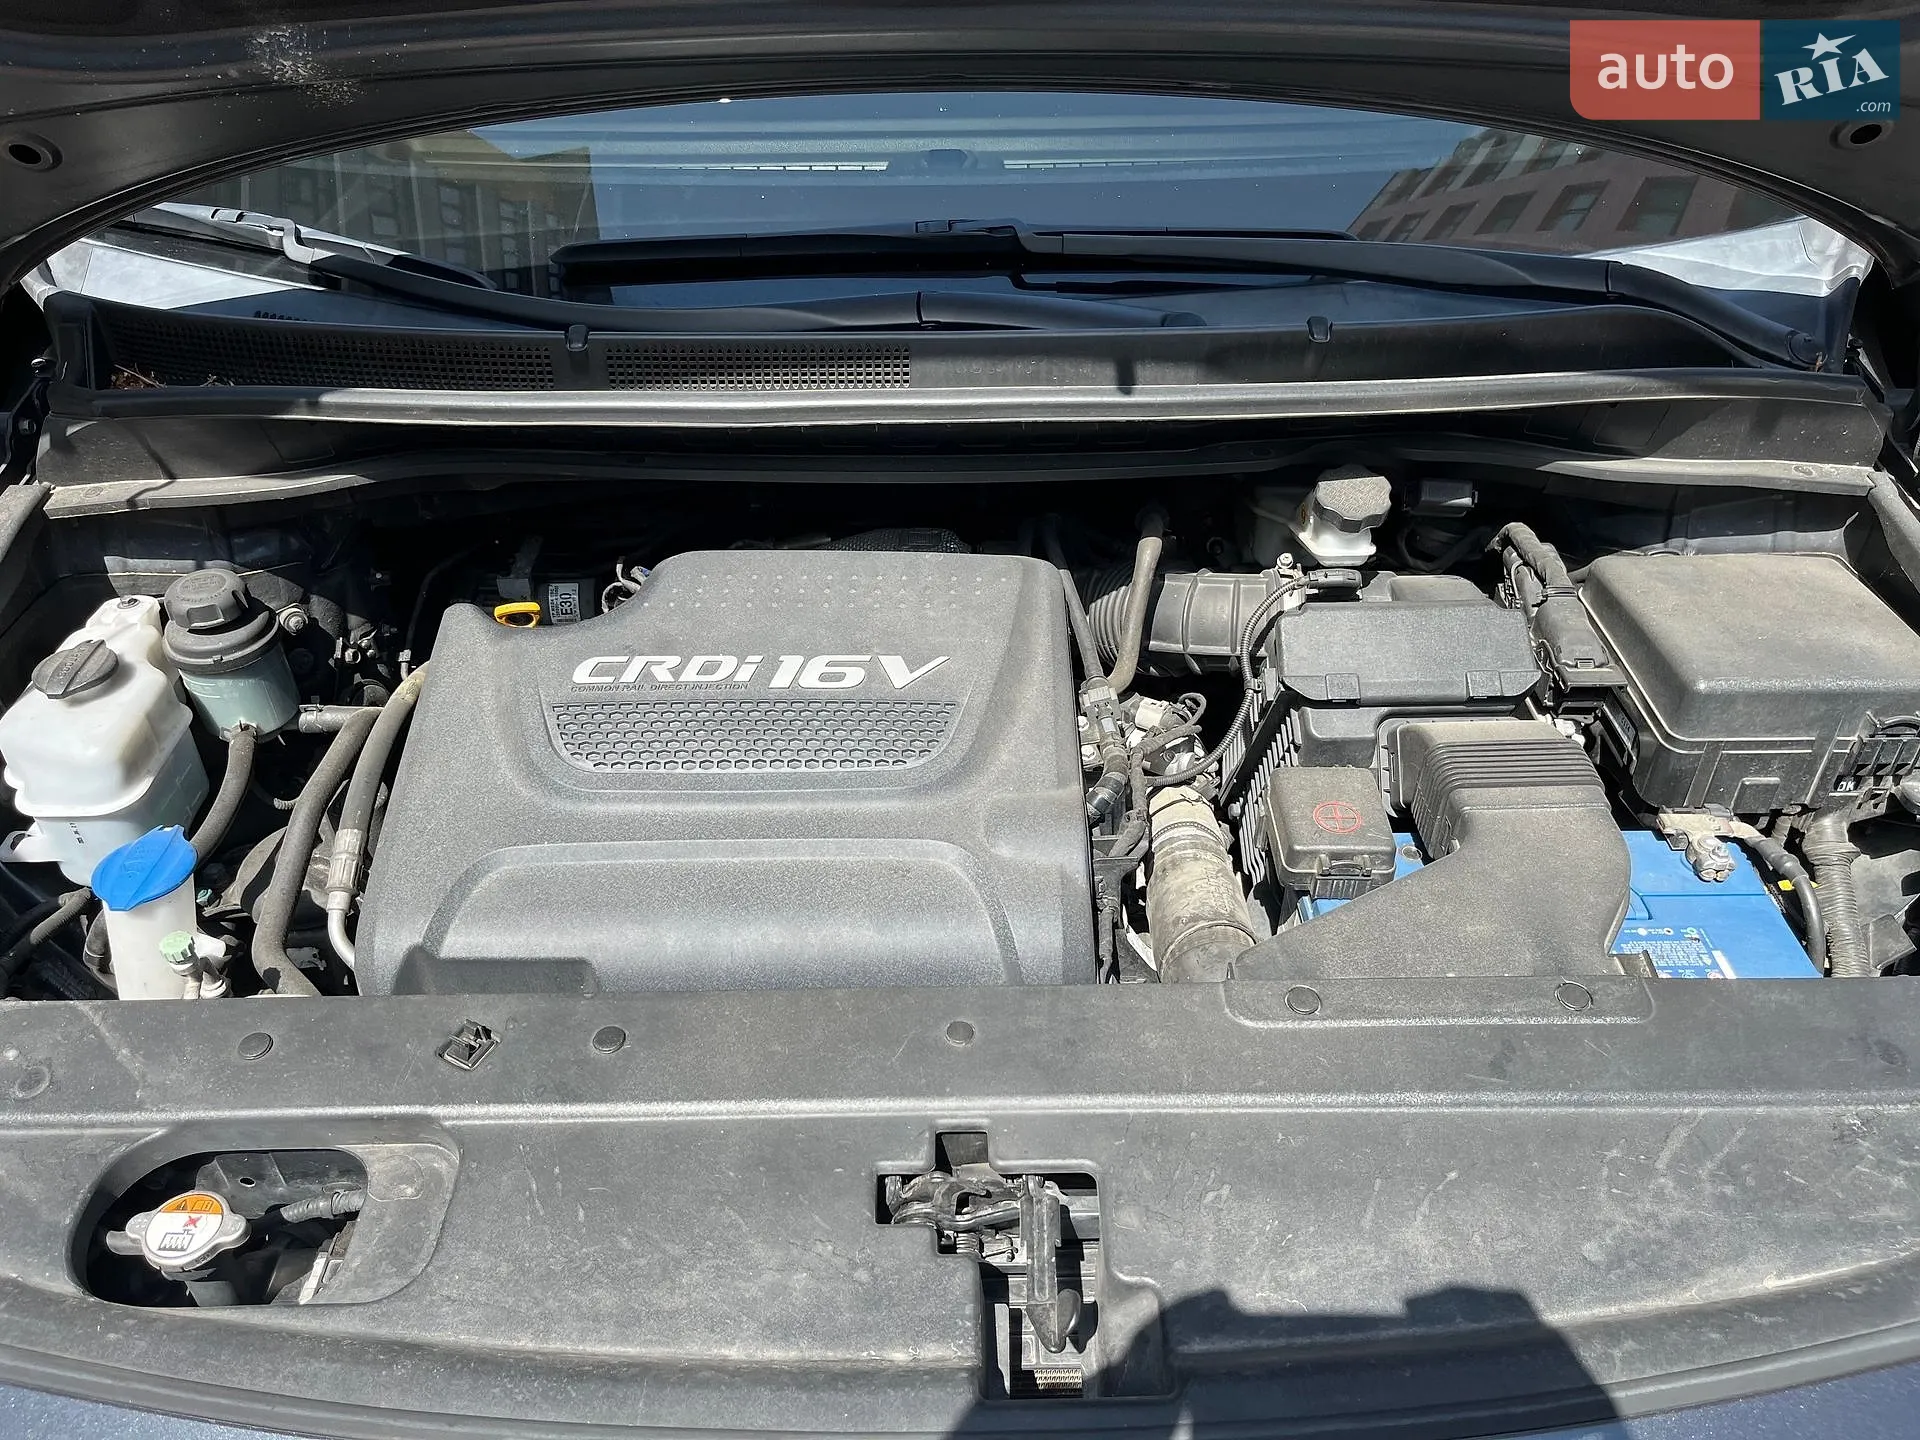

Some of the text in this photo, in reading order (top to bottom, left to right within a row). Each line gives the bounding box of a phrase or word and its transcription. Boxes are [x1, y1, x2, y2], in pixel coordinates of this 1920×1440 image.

[559, 592, 573, 616] E30
[571, 654, 952, 690] CRDi 16V
[570, 683, 749, 693] COMMON RAIL DIRECT INJECTION
